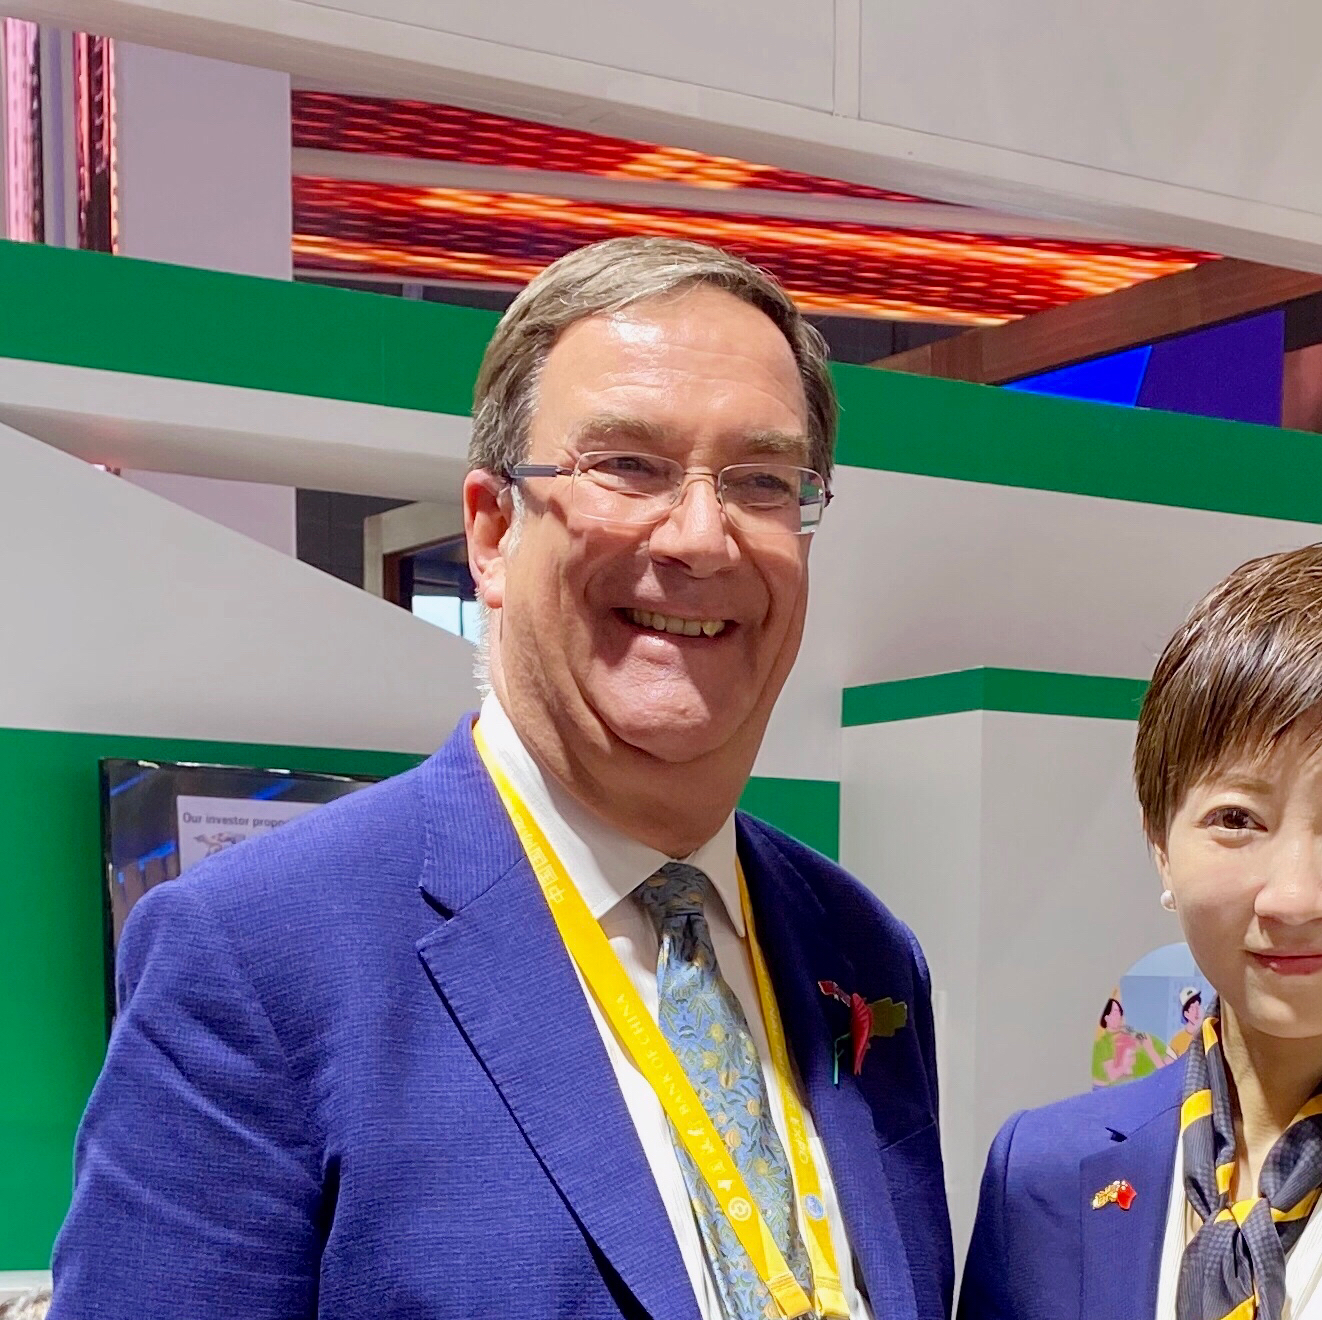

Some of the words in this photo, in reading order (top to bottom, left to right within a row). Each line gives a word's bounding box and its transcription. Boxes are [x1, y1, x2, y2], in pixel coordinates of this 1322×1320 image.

[183, 812, 202, 823] Our
[205, 814, 249, 826] investor
[615, 993, 651, 1047] CHINA
[647, 1048, 666, 1072] OF
[663, 1073, 692, 1116] BANK
